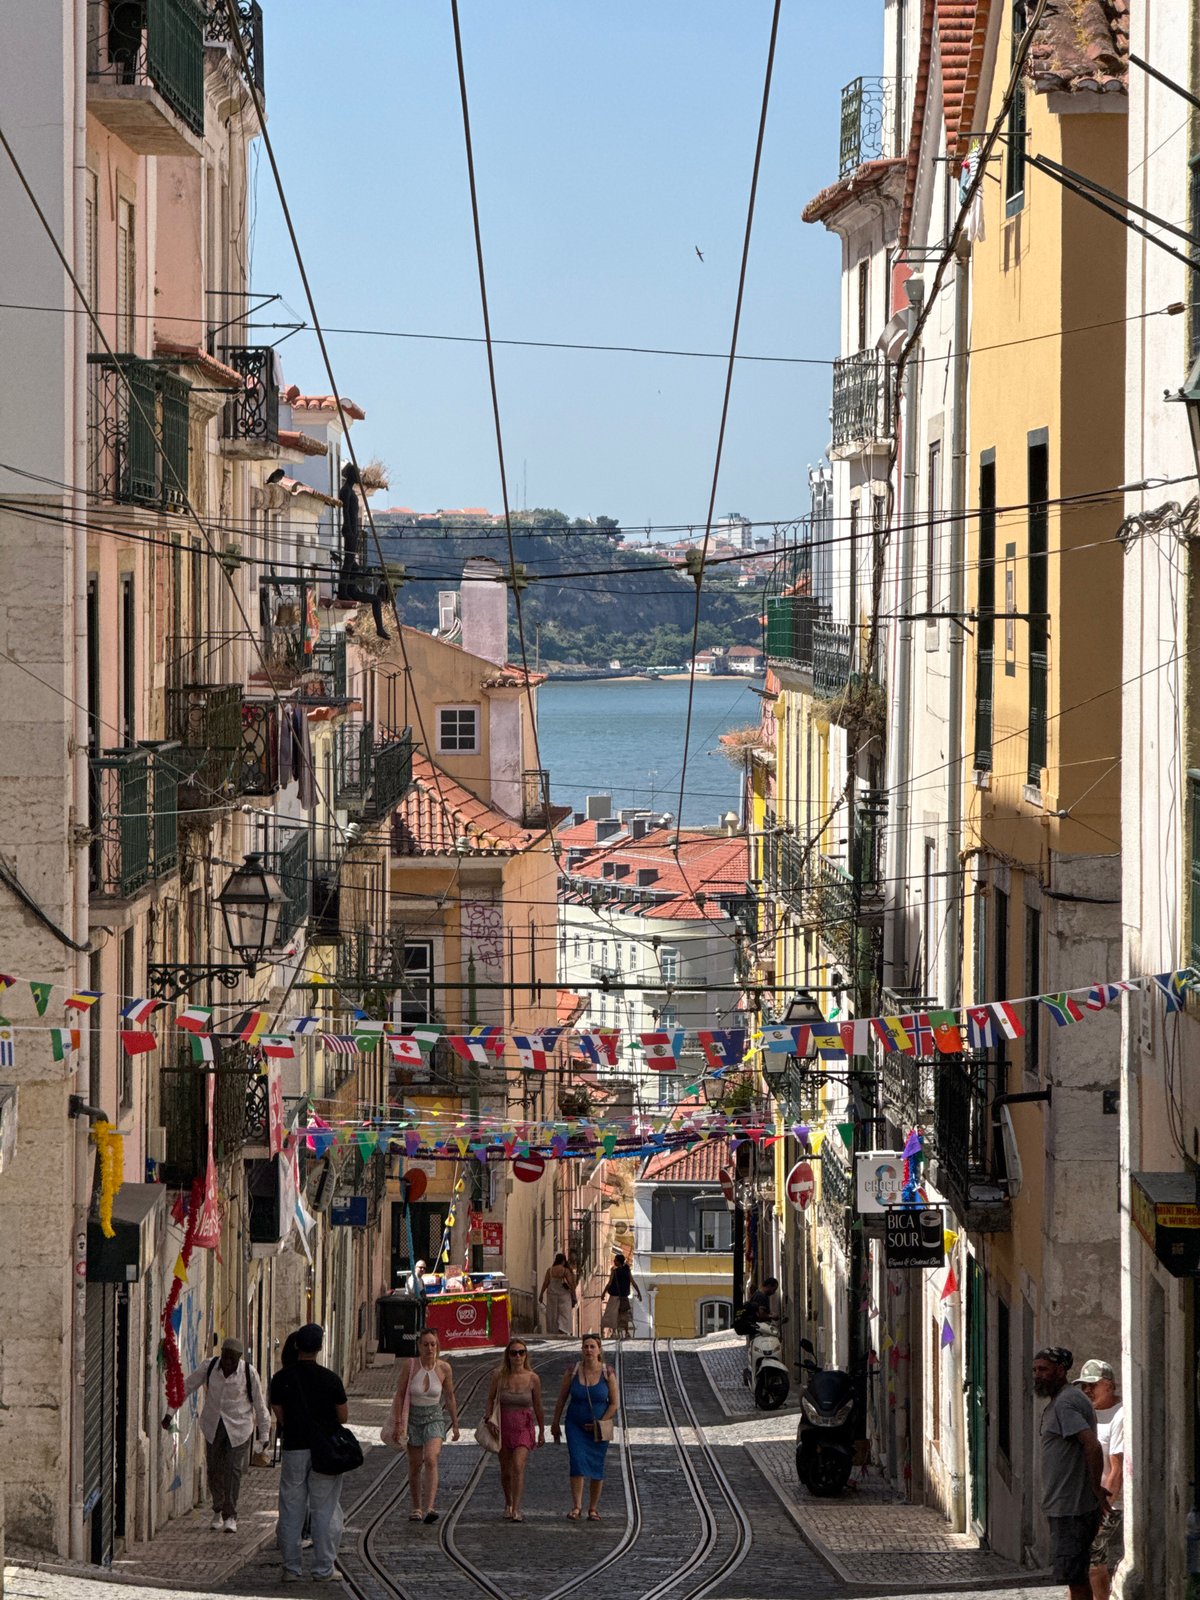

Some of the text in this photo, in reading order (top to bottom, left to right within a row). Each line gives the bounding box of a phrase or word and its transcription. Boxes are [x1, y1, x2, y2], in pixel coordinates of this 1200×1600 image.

[888, 1214, 915, 1229] BICA
[888, 1232, 919, 1247] SOUR
[930, 1256, 941, 1266] Bar
